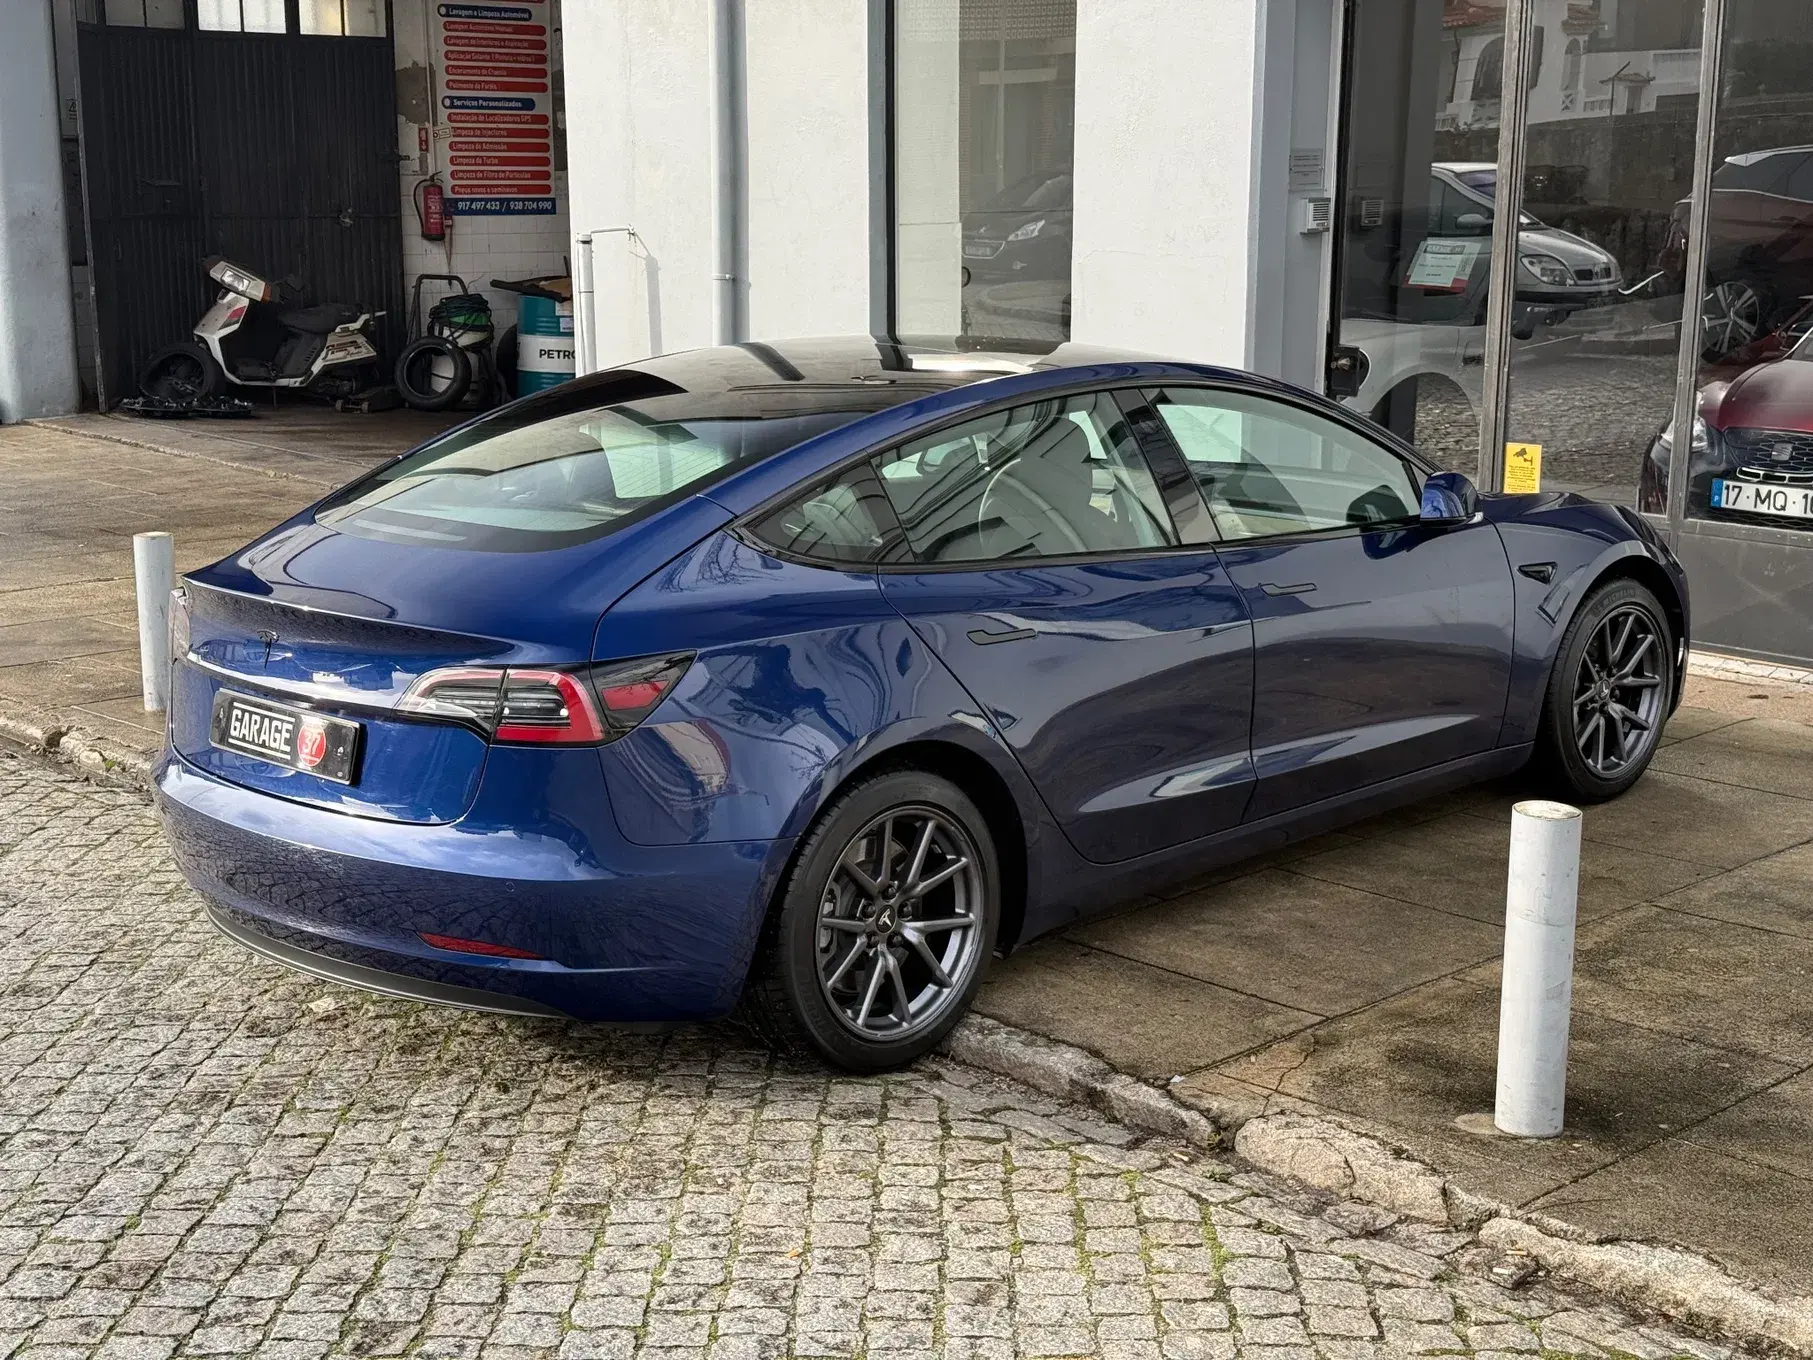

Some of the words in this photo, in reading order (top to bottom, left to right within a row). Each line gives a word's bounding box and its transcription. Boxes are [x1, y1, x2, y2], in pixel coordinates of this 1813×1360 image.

[449, 8, 472, 16] Lavagem
[478, 9, 500, 18] Limpeza
[501, 10, 529, 18] Automóvel
[457, 202, 469, 210] 917
[471, 202, 485, 210] 497
[486, 202, 500, 210] 433
[524, 202, 537, 210] 704
[538, 202, 552, 210] 990
[1724, 484, 1743, 506] 17
[1754, 488, 1788, 512] MQ
[230, 709, 293, 752] GARAGE
[302, 730, 321, 755] 37
